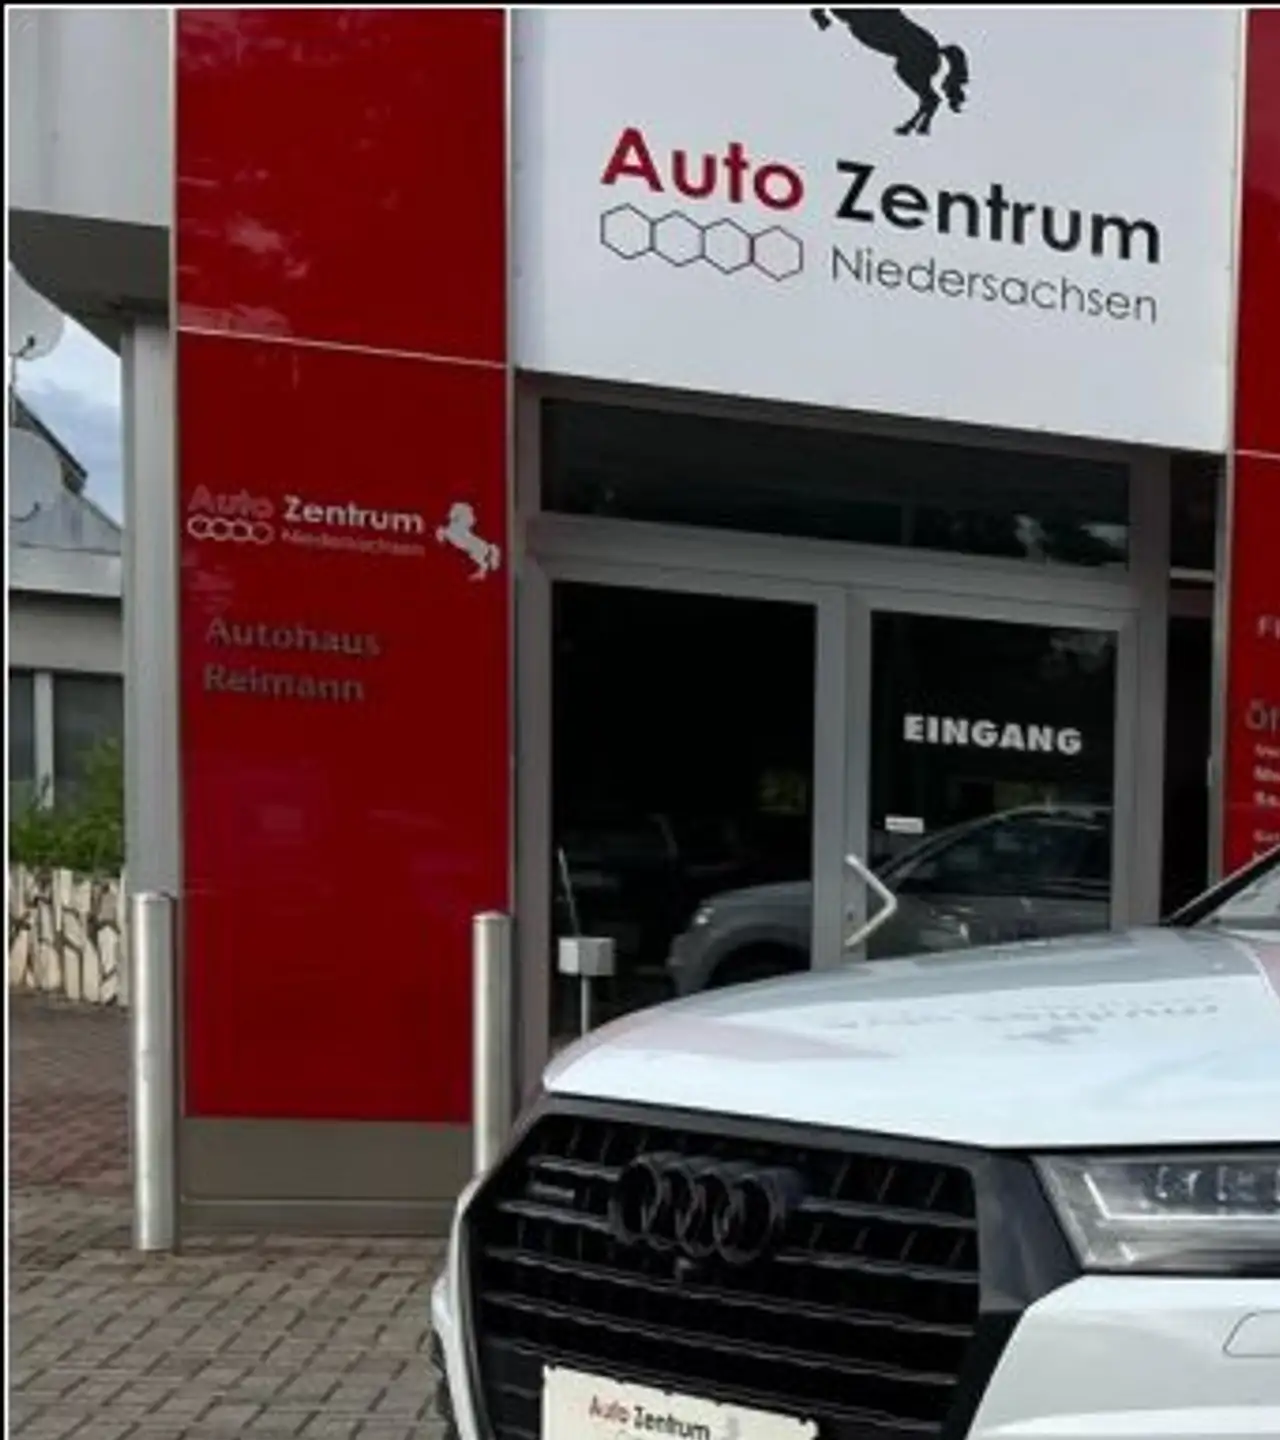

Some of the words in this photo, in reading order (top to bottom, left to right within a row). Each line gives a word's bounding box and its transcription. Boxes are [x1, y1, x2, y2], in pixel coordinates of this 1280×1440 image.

[600, 127, 804, 211] Auto
[835, 160, 1160, 263] Zentrum
[831, 246, 1157, 323] Niedersachsen
[188, 485, 274, 519] Auto
[284, 495, 424, 534] Zentrum
[206, 618, 380, 656] Autohaus
[205, 664, 363, 702] Reimann
[904, 714, 1082, 755] EINGANG
[588, 1396, 629, 1425] Auto
